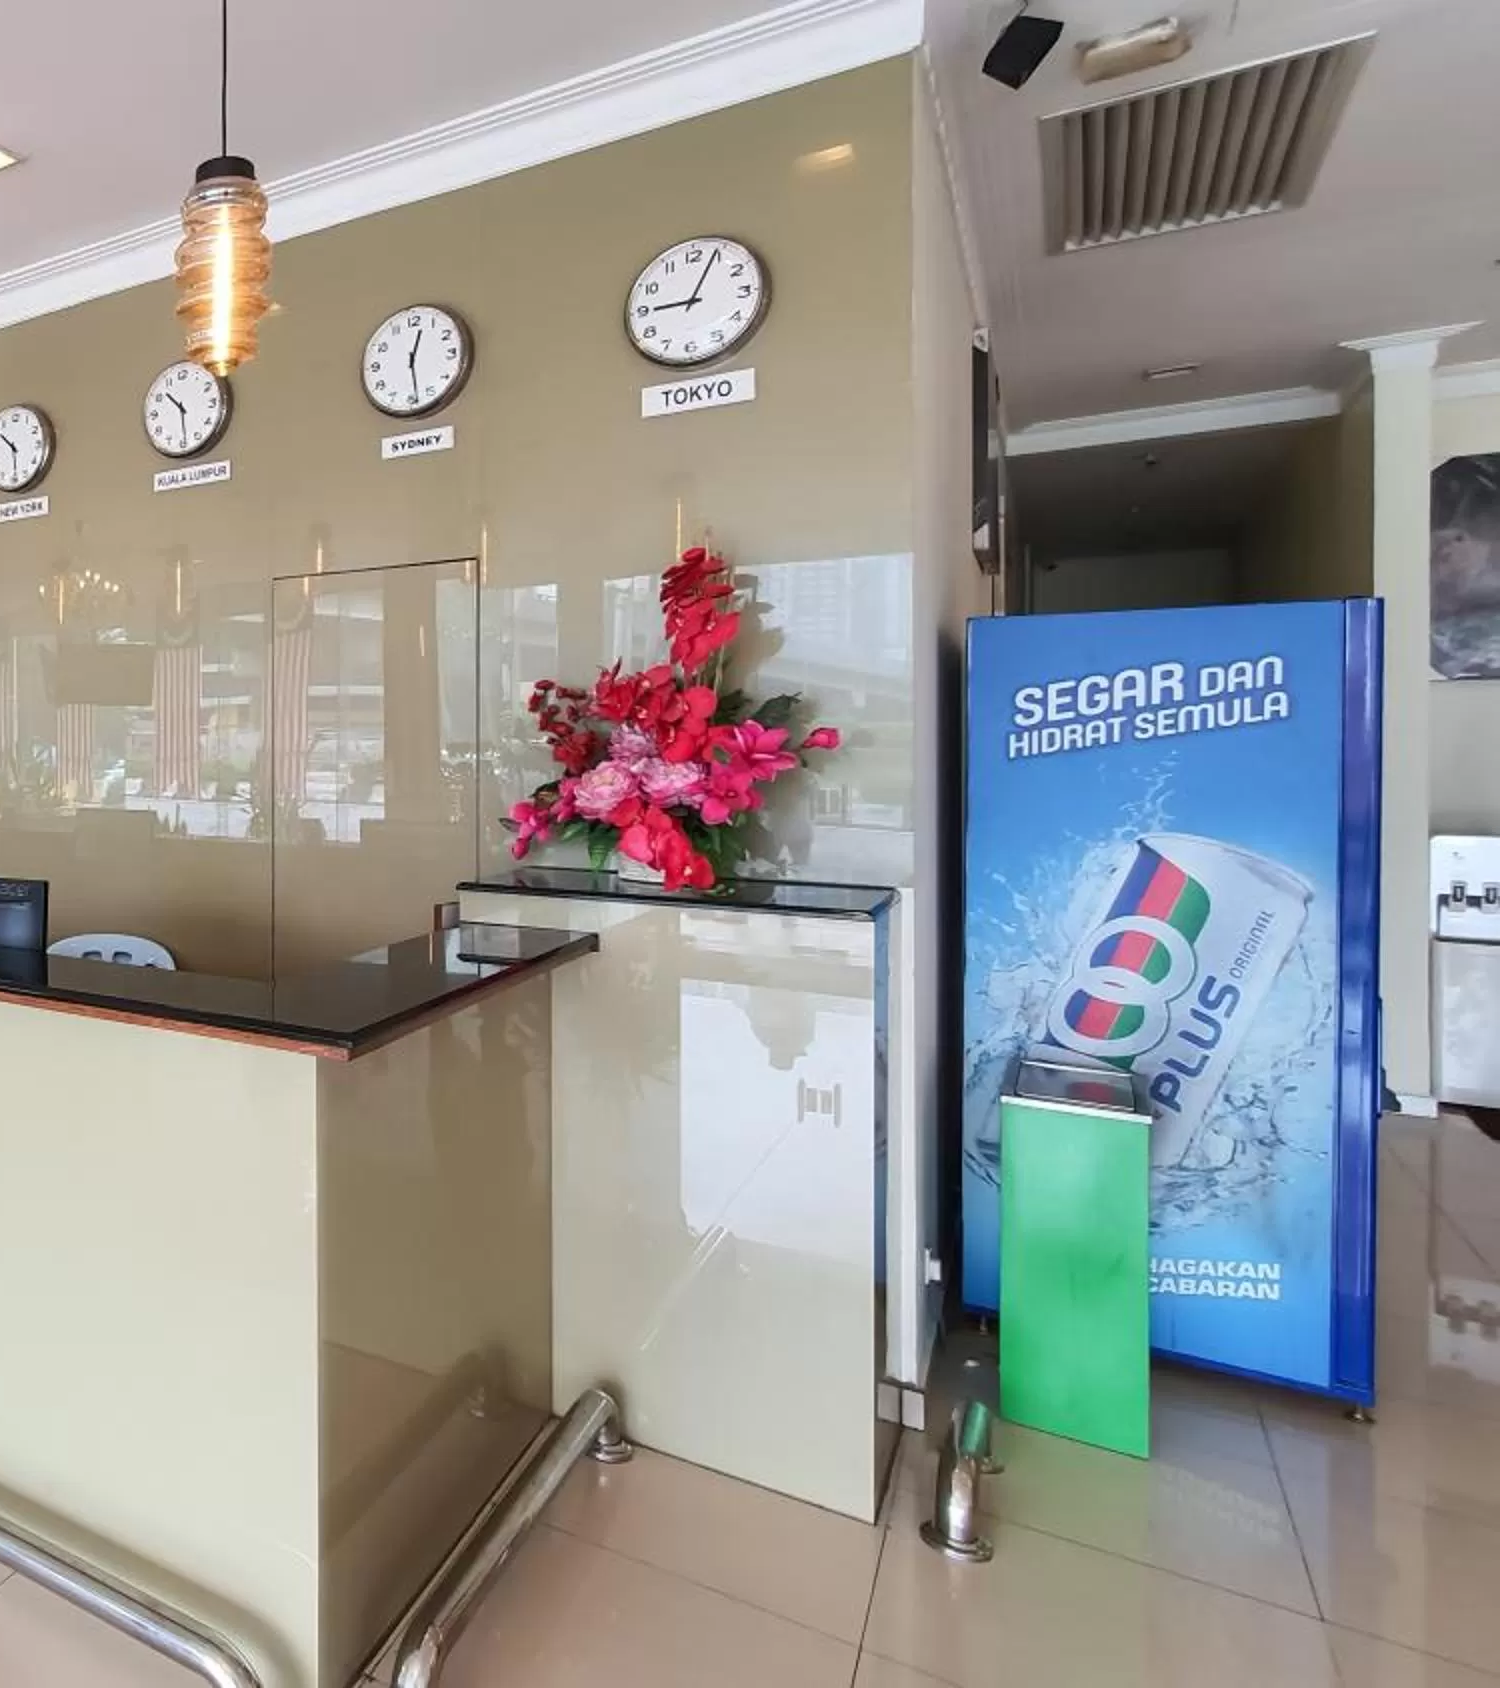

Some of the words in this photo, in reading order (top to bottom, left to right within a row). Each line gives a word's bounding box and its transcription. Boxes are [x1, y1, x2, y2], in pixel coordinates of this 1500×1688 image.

[685, 250, 703, 264] 12
[665, 262, 675, 275] 11
[730, 264, 744, 277] 2
[645, 282, 659, 295] 10
[737, 285, 751, 299] 3
[637, 305, 649, 318] 9
[407, 315, 421, 328] 12
[441, 330, 451, 341] 2
[643, 326, 657, 338] 8
[711, 330, 724, 343] 5
[661, 337, 673, 351] 7
[370, 361, 381, 373] 9
[661, 380, 733, 407] TOKYO
[391, 434, 443, 453] SYDNEY
[157, 473, 187, 487] KUALA
[189, 465, 228, 481] LUMPUR
[0, 504, 19, 517] NEW
[20, 502, 43, 513] YORK
[1013, 661, 1185, 727] SEGAR
[1200, 655, 1283, 697] DAN
[1007, 716, 1127, 759] HIDRAT
[1134, 690, 1290, 740] SEMULA
[1149, 975, 1241, 1114] PLUS
[1229, 909, 1276, 979] ORIGINAL
